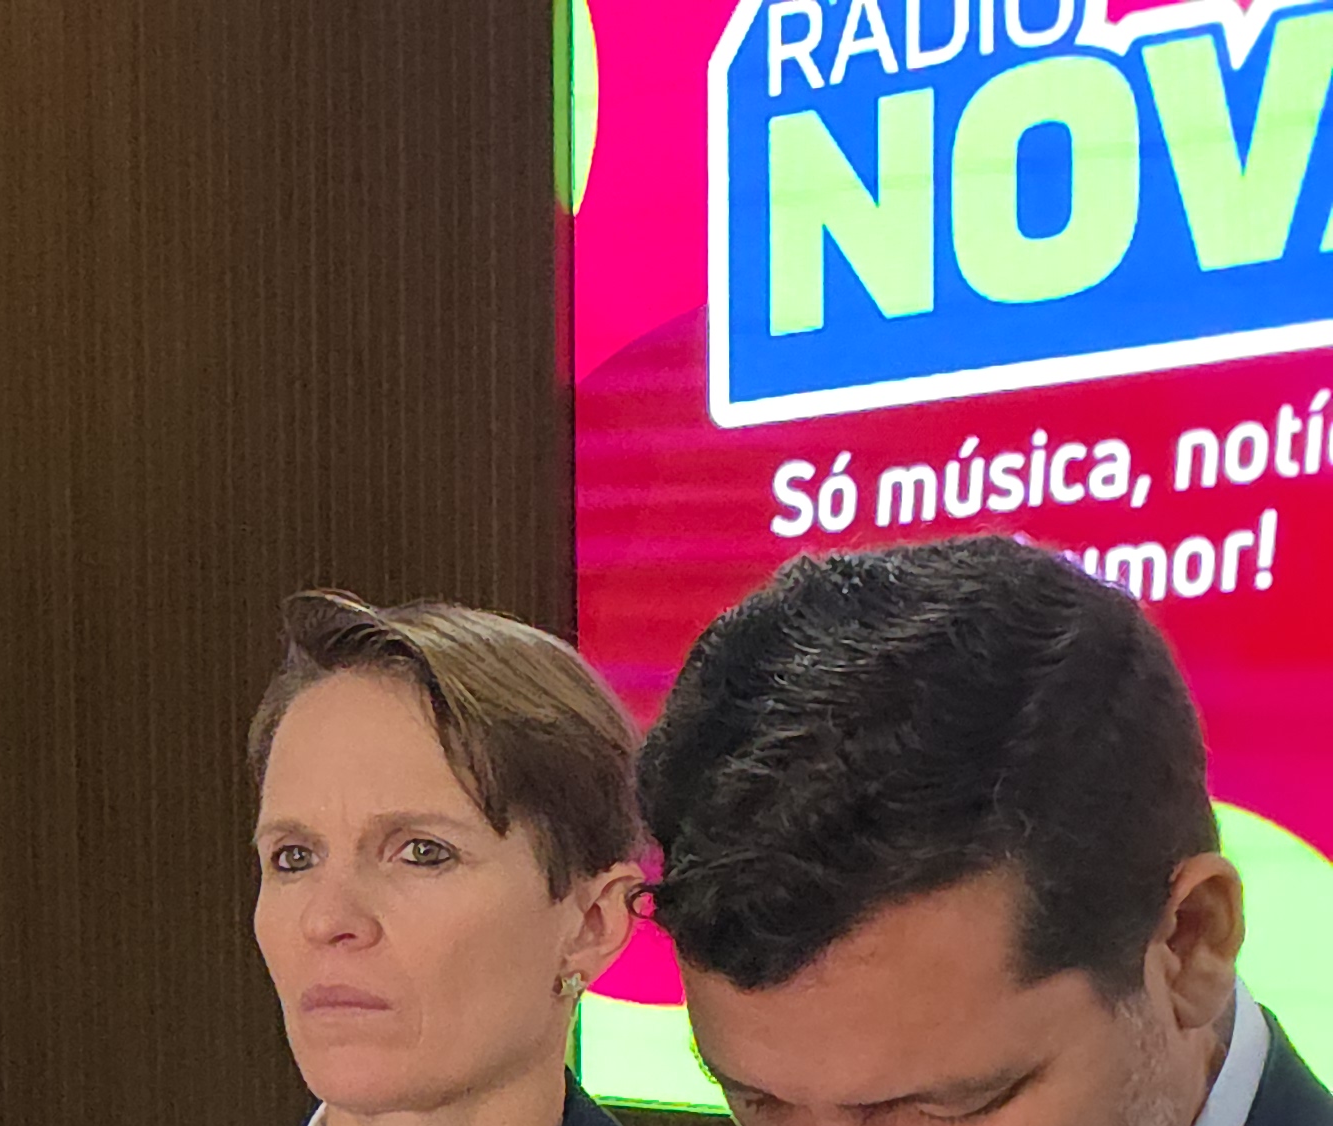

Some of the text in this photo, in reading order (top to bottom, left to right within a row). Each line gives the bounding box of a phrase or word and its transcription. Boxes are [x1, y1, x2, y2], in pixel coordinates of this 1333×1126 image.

[768, 11, 1333, 337] NOV
[770, 387, 1333, 538] Só música, notí
